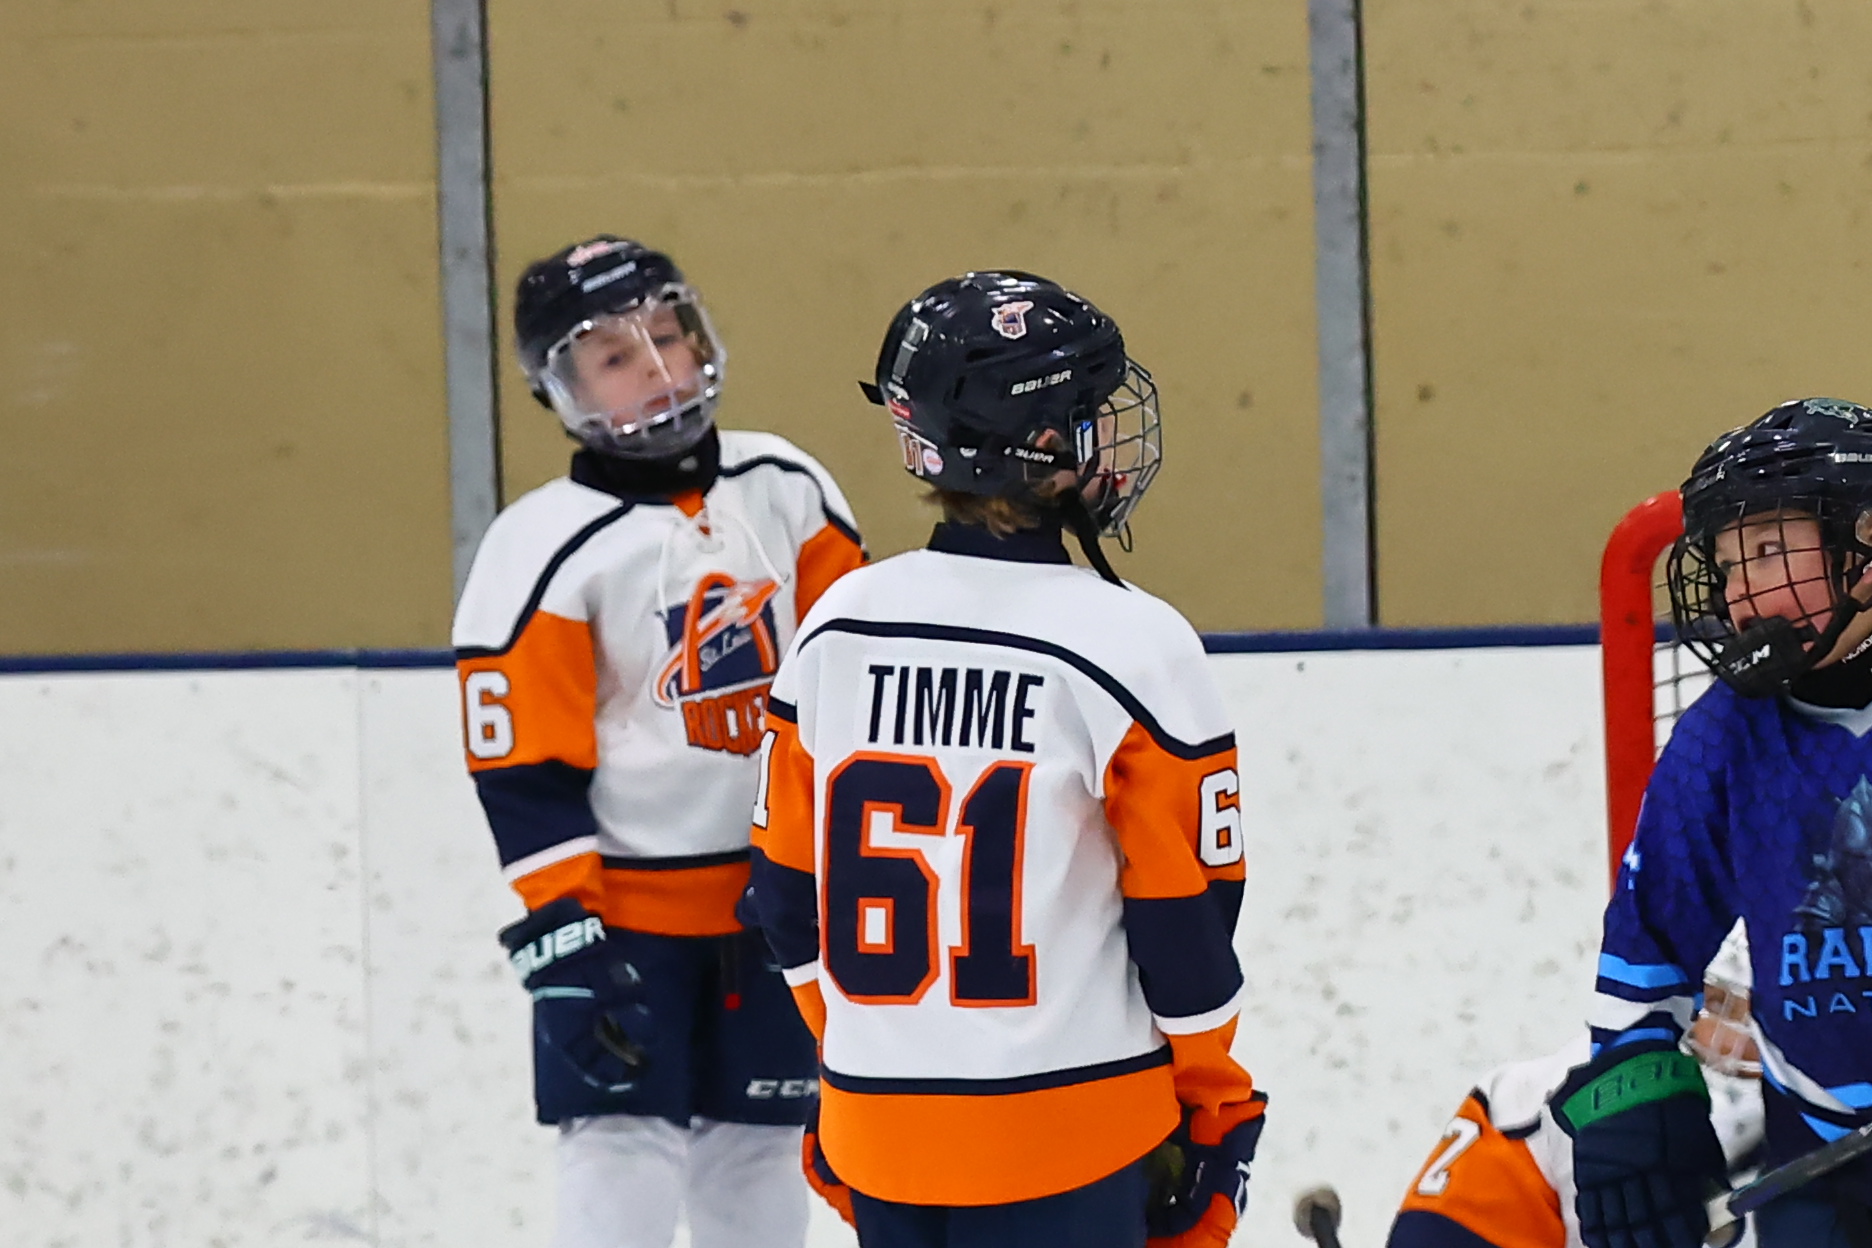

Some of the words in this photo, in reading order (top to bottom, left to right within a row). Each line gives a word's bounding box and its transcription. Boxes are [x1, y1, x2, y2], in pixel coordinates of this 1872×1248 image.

[466, 670, 515, 760] 6
[868, 664, 1045, 753] TIMME
[1199, 768, 1244, 867] 6
[822, 750, 1038, 1008] 61
[1417, 1115, 1481, 1196] 2
